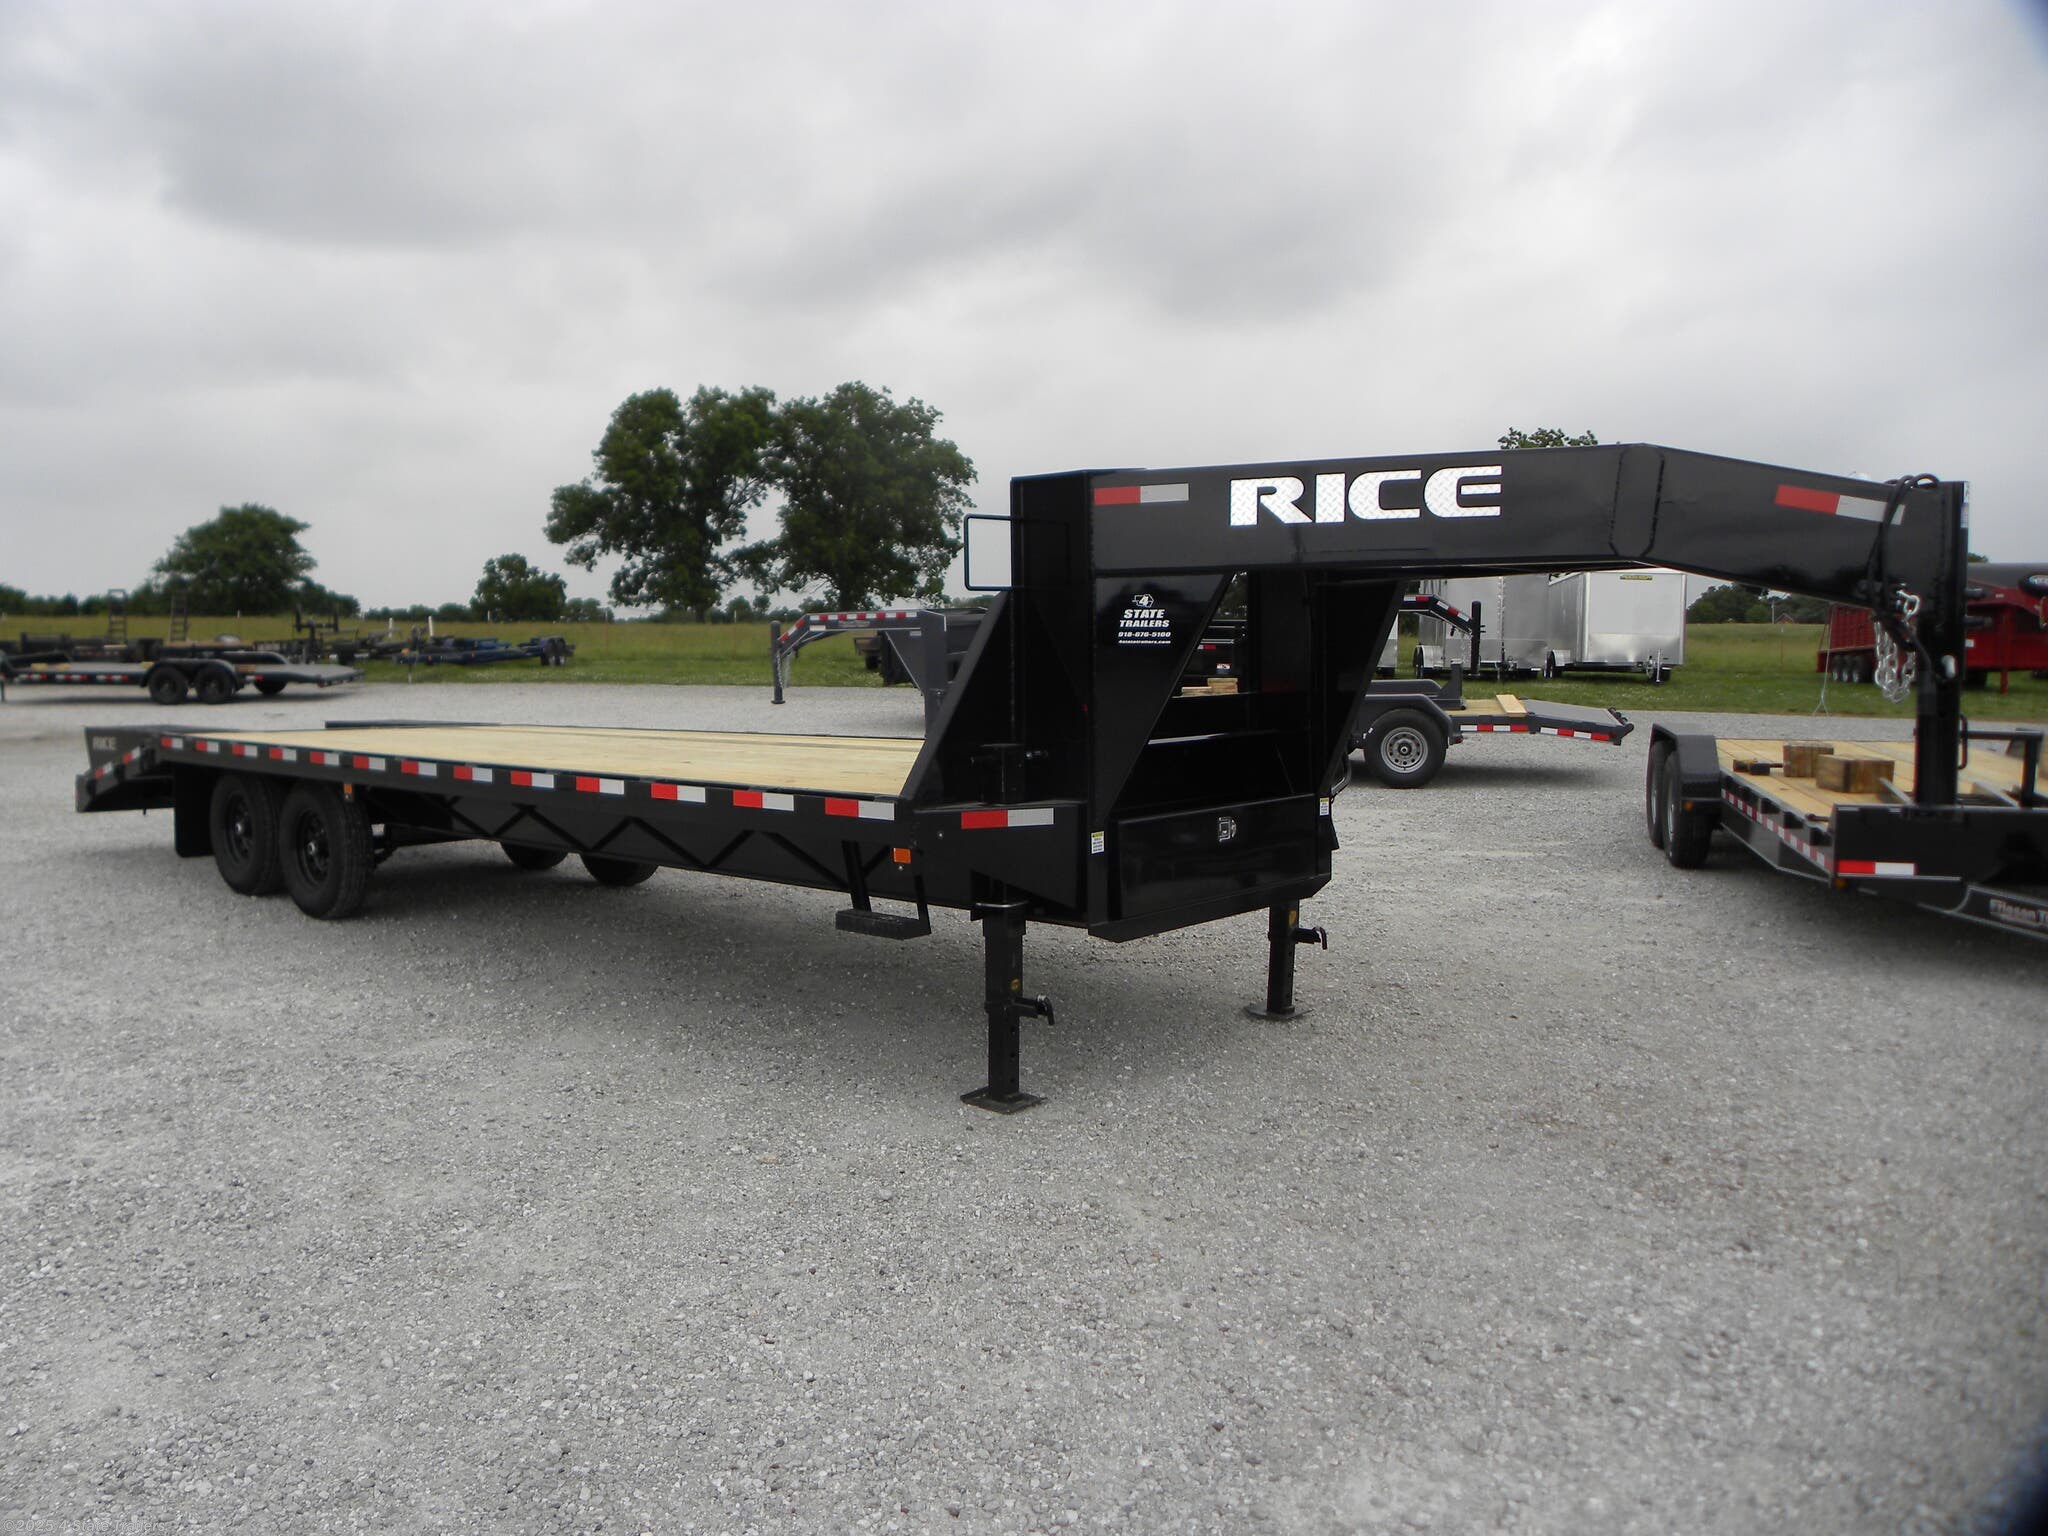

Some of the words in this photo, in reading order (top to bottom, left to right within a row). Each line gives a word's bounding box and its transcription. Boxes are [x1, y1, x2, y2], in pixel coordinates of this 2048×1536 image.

[1230, 465, 1502, 526] RICE
[1123, 609, 1165, 619] STATE
[1119, 619, 1170, 628] TRAILERS
